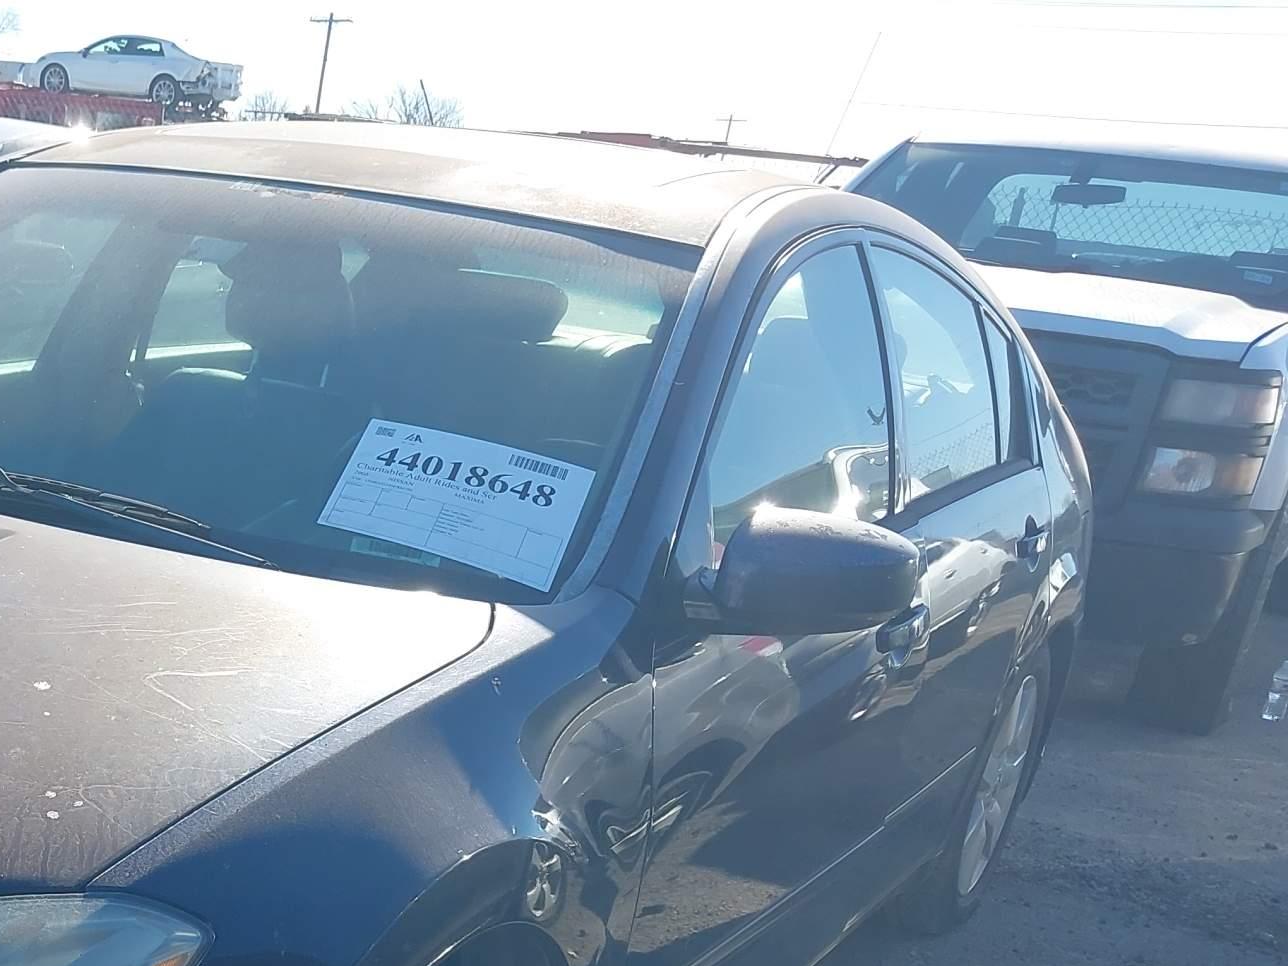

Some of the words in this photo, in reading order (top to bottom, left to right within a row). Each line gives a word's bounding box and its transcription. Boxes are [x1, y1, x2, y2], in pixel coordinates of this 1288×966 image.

[357, 463, 405, 477] Charitable
[406, 472, 432, 484] Adult
[433, 478, 460, 490] Rides
[462, 486, 480, 496] and
[376, 447, 556, 507] 44018648
